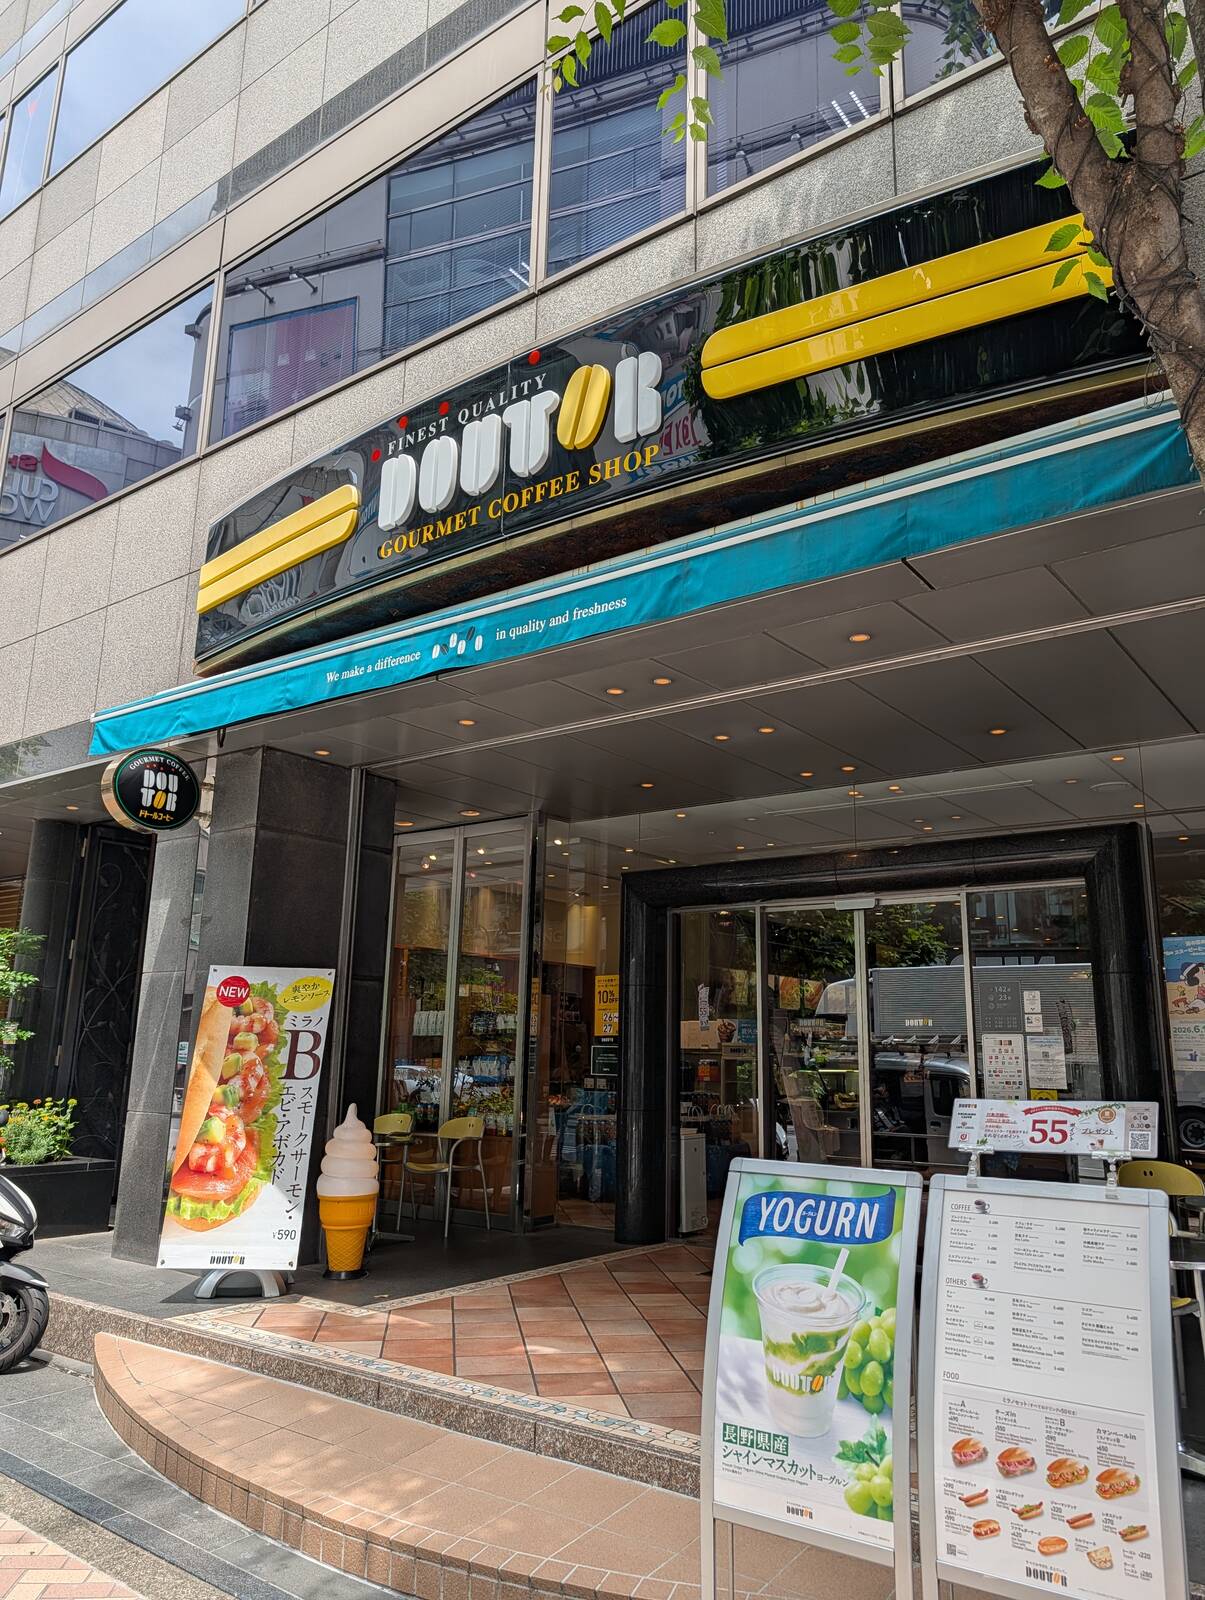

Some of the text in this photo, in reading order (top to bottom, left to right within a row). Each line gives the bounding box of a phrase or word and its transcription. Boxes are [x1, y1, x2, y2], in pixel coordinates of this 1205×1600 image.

[387, 373, 547, 456] FINEST QUALITY
[378, 350, 663, 531] DOUTOR
[379, 505, 481, 560] GOURMET
[488, 470, 580, 520] COFFEE
[588, 444, 660, 486] SHOP
[495, 597, 628, 641] in quality and freshness
[326, 650, 421, 684] We make a difference
[129, 755, 191, 782] GOURMET COFFEE
[139, 809, 174, 822] ドトールコーヒー
[219, 985, 249, 999] NEW
[283, 990, 330, 1003] レモンソース
[292, 982, 320, 993] 爽やか
[290, 1014, 323, 1028] ミラノ
[279, 1030, 323, 1081] B
[271, 1086, 297, 1186] エビ・アボカド
[1029, 1118, 1068, 1145] 55
[1081, 1127, 1115, 1136] プレゼント
[759, 1196, 880, 1240] YOGURN
[951, 1203, 971, 1211] COFFEE
[272, 1229, 297, 1241] ¥590
[945, 1277, 967, 1287] OTHERS
[943, 1371, 960, 1380] FOOD
[723, 1424, 788, 1455] 長野県産
[1025, 1565, 1068, 1587] DOUTOR
